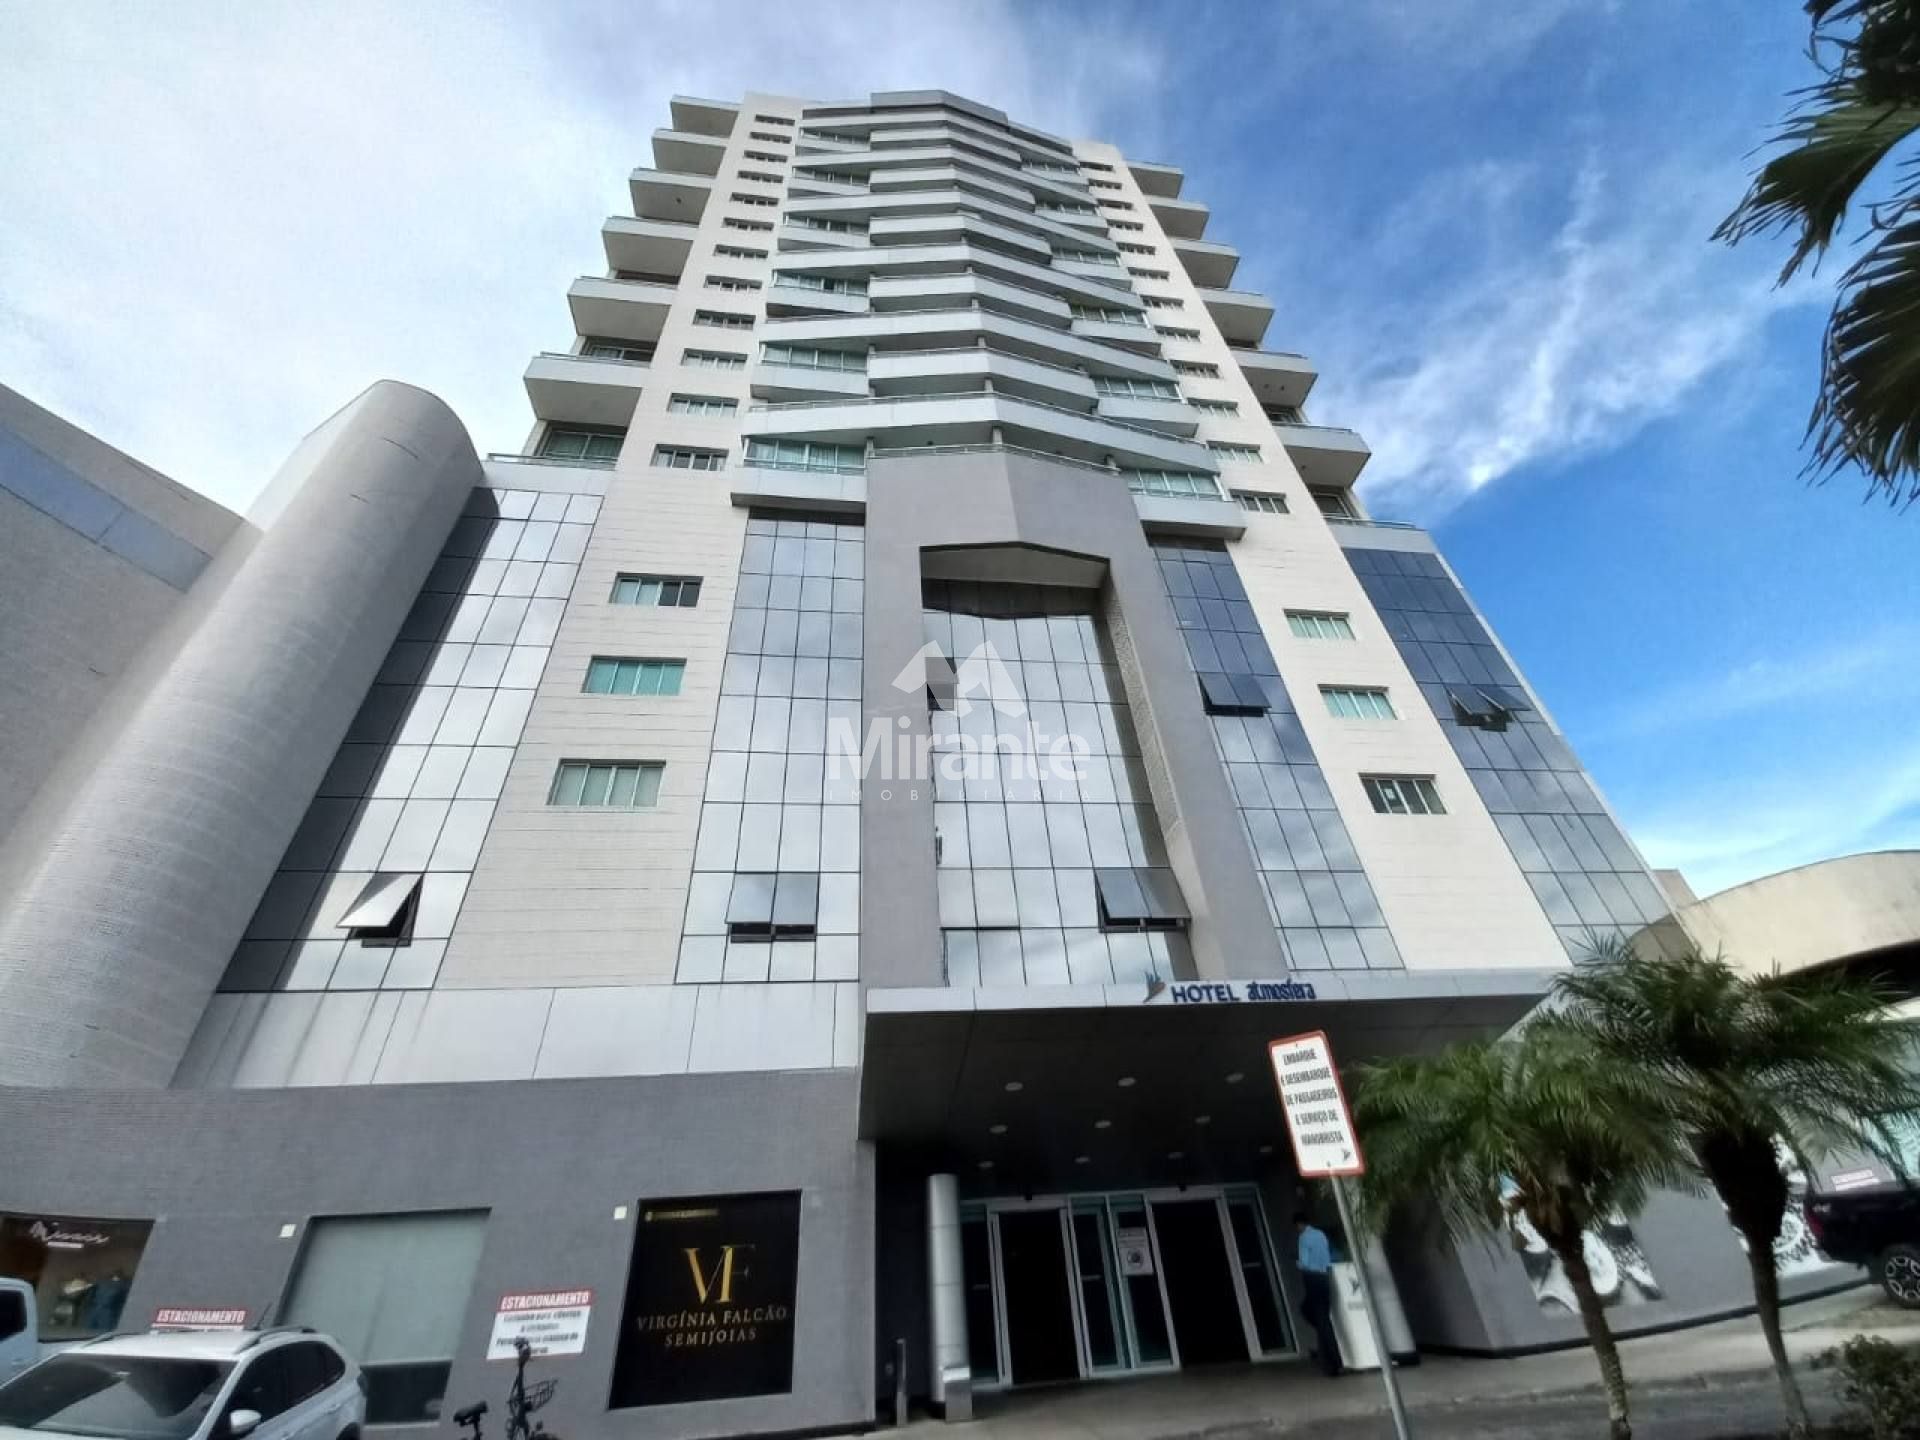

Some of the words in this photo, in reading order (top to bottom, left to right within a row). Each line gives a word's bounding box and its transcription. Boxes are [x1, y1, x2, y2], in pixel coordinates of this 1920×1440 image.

[1171, 983, 1240, 1003] HOTEL
[501, 1291, 590, 1310] ESTACIONAMENTO
[156, 1309, 247, 1324] ESTACIONAMENTO
[636, 1309, 717, 1331] VIRGÍNIA
[722, 1304, 788, 1325] FALCÃO
[664, 1327, 757, 1347] SEMIJOIAS
